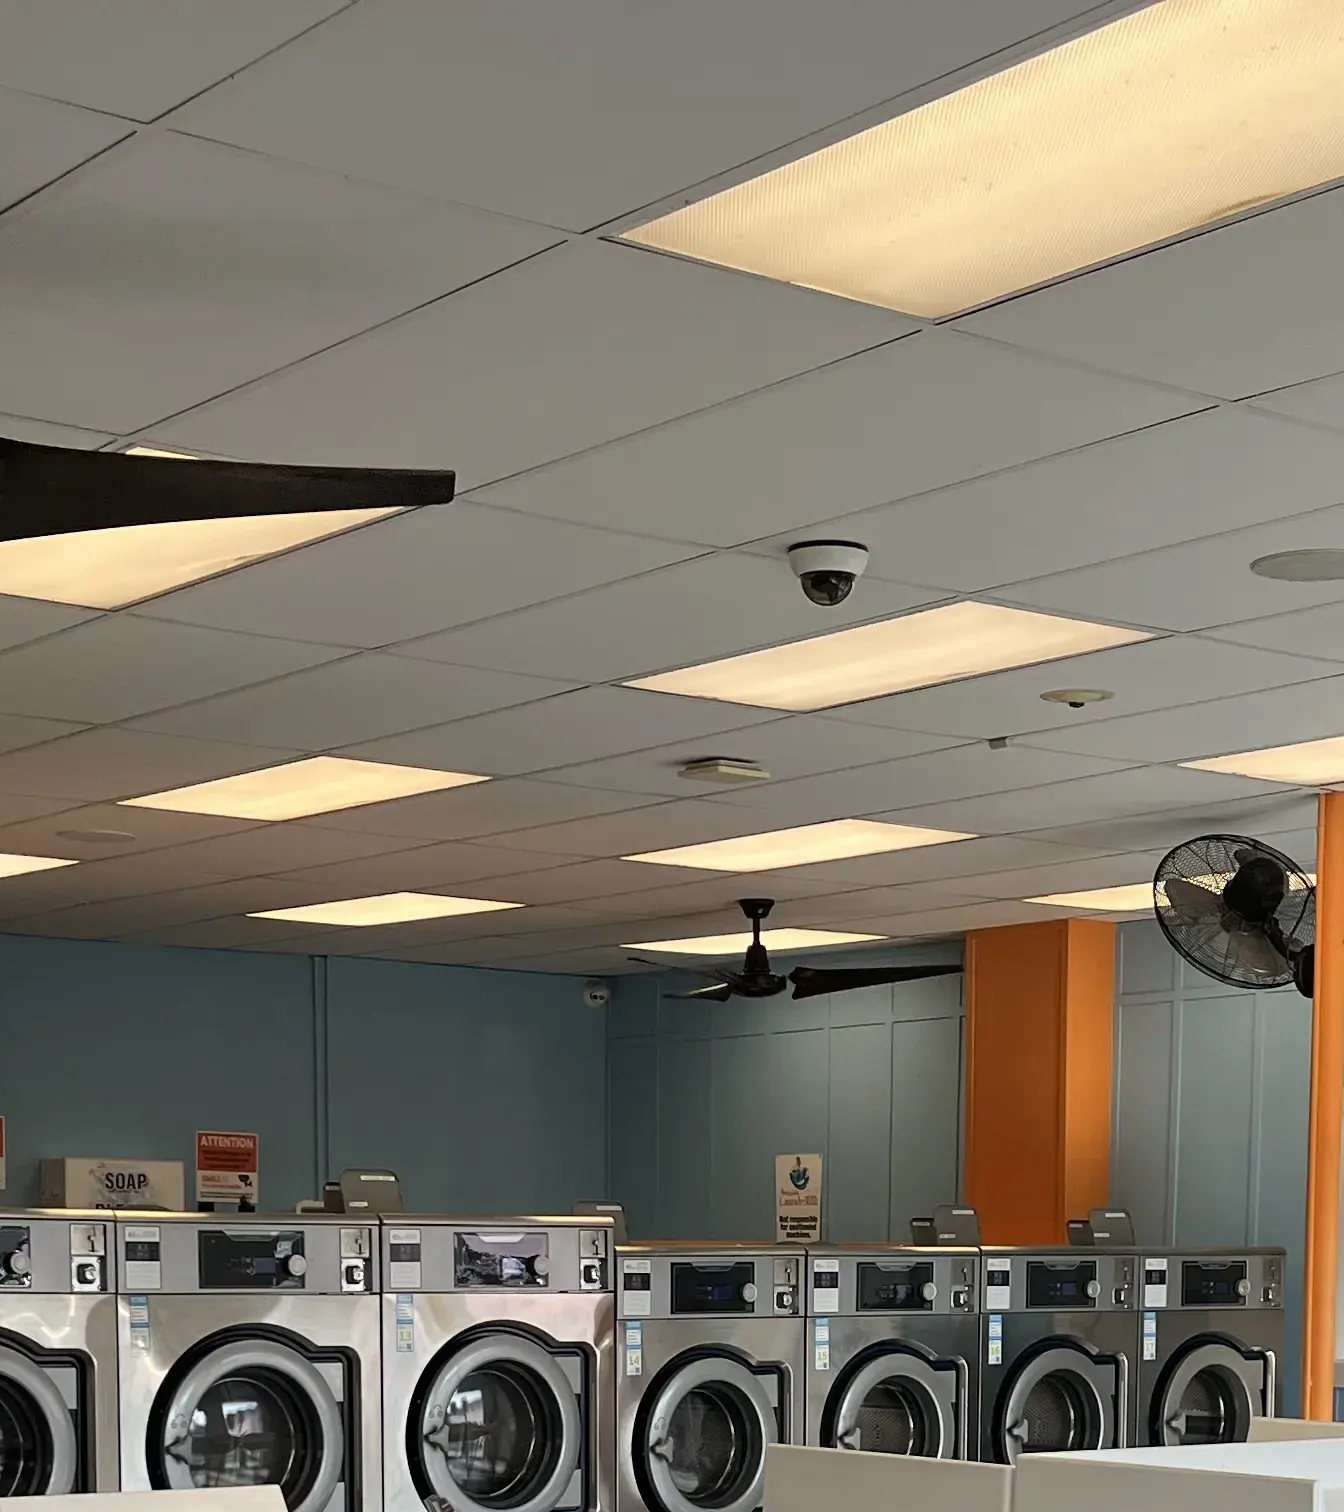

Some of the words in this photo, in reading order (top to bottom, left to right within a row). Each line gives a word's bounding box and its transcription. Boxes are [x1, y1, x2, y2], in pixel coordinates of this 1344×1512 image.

[200, 1135, 254, 1148] ATTENTION
[105, 1172, 147, 1190] SOAP
[629, 1355, 640, 1365] 14
